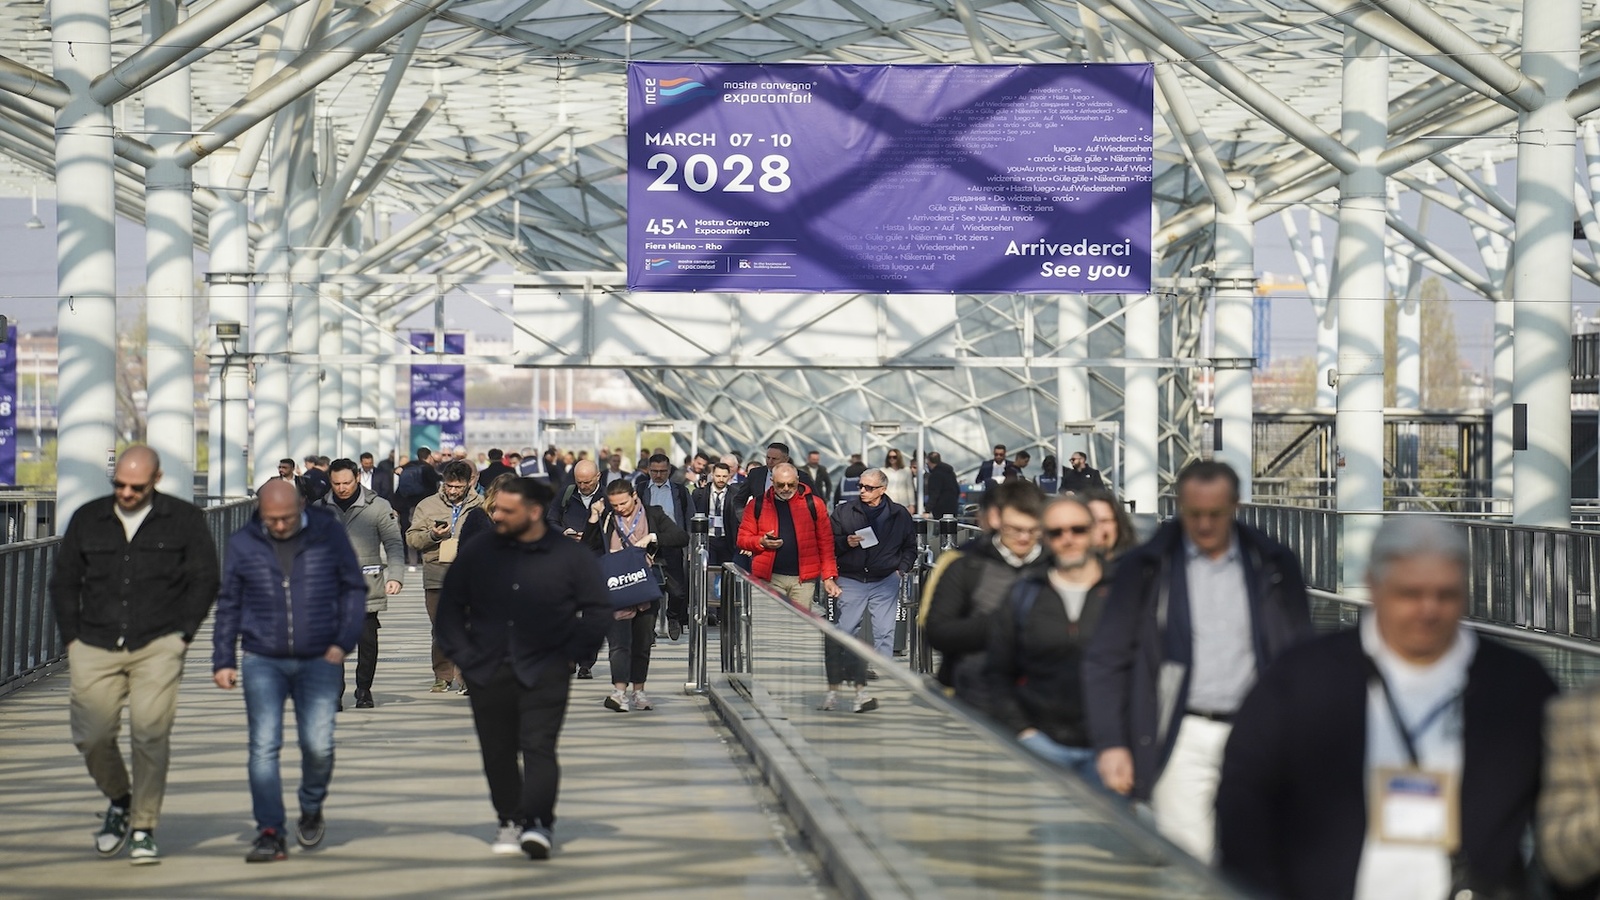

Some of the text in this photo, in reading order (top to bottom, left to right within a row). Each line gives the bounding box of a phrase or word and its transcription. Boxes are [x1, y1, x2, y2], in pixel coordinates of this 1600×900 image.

[723, 81, 757, 89] mostra
[646, 78, 656, 104] mce
[723, 92, 812, 105] expocomfort
[646, 133, 715, 146] MARCH
[730, 134, 753, 146] 07
[771, 134, 791, 147] 10
[1054, 145, 1076, 153] luego
[1085, 155, 1101, 163] güle
[647, 154, 791, 192] 2028
[1087, 165, 1109, 173] luego
[1072, 175, 1089, 183] güle
[1033, 185, 1055, 193] luego
[949, 204, 966, 212] güle
[975, 204, 1010, 212] Näkemiin
[1035, 204, 1054, 212] ziens
[726, 220, 769, 228] Convegno
[909, 224, 930, 232] luego
[885, 234, 902, 242] güle
[866, 243, 888, 251] luego
[1005, 239, 1131, 256] Arrivederci
[875, 253, 893, 261] güle
[892, 263, 914, 271] luego
[1041, 262, 1131, 281] See you
[415, 407, 461, 422] 2028
[618, 568, 646, 585] Frigel
